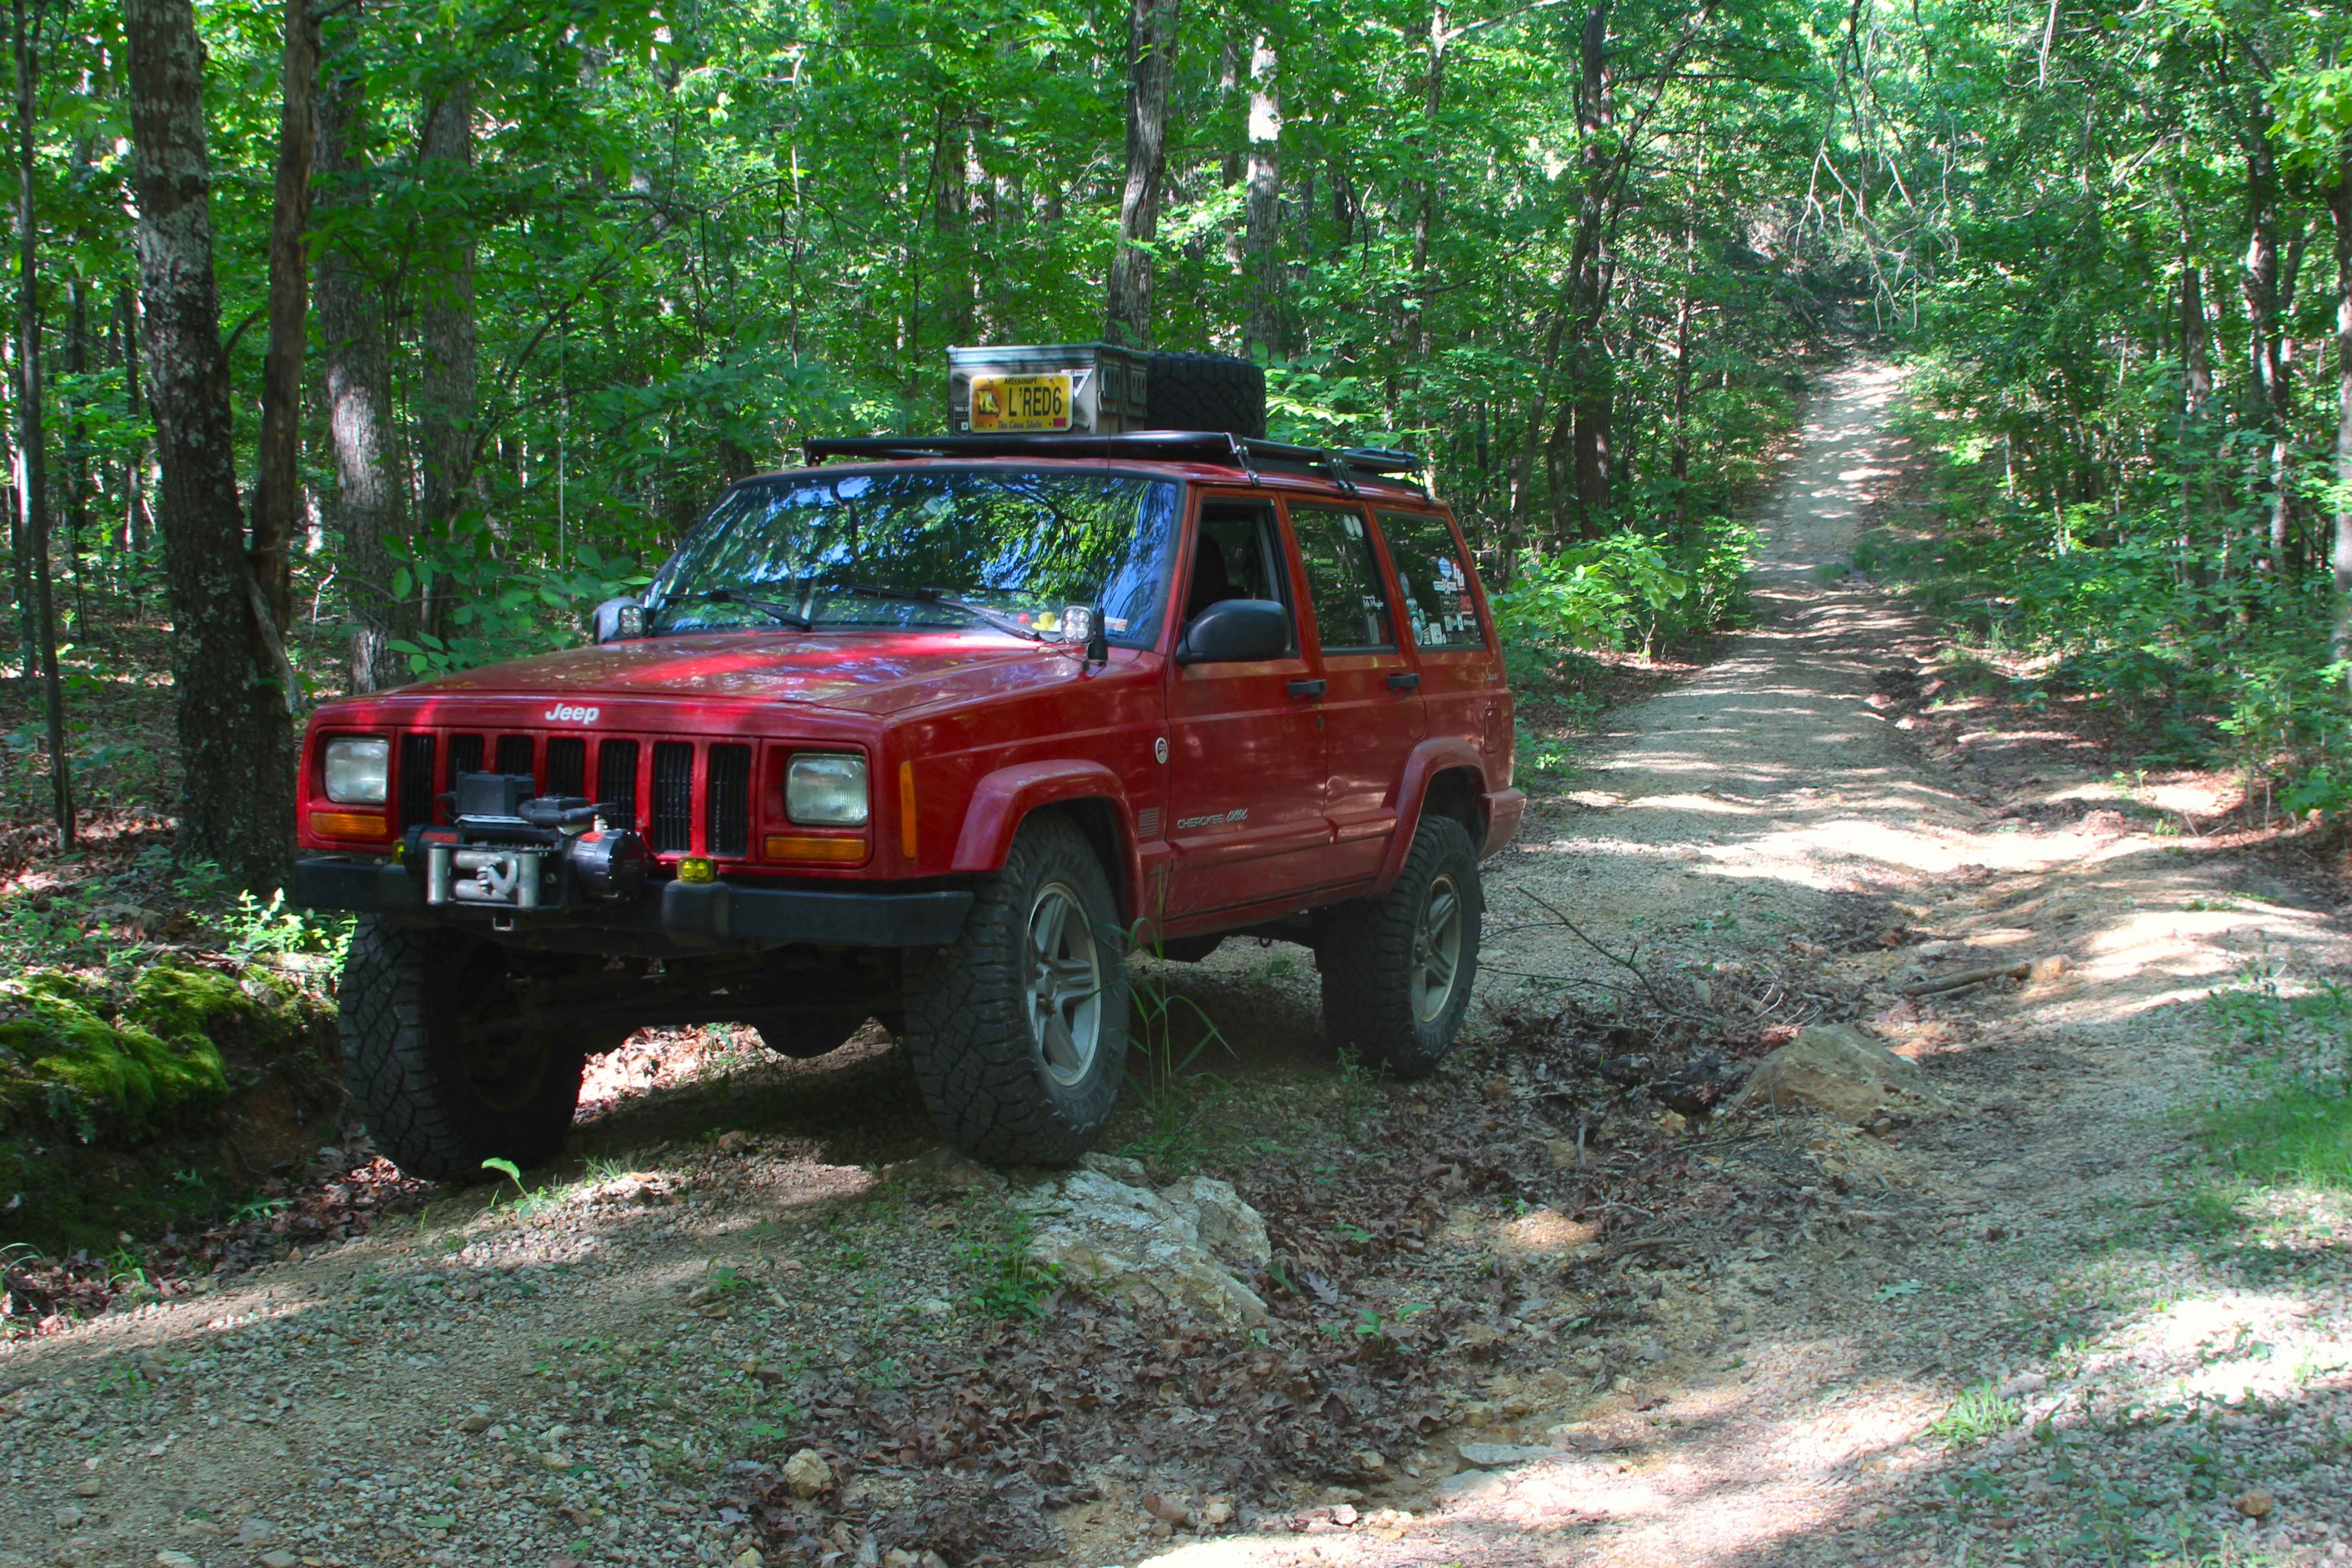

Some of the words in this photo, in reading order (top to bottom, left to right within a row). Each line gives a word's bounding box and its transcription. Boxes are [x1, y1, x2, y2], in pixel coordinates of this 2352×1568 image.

[1004, 377, 1037, 385] Missouri
[1009, 387, 1062, 417] L'RED6
[545, 703, 600, 725] Jeep
[1177, 814, 1224, 829] CHEROKEE
